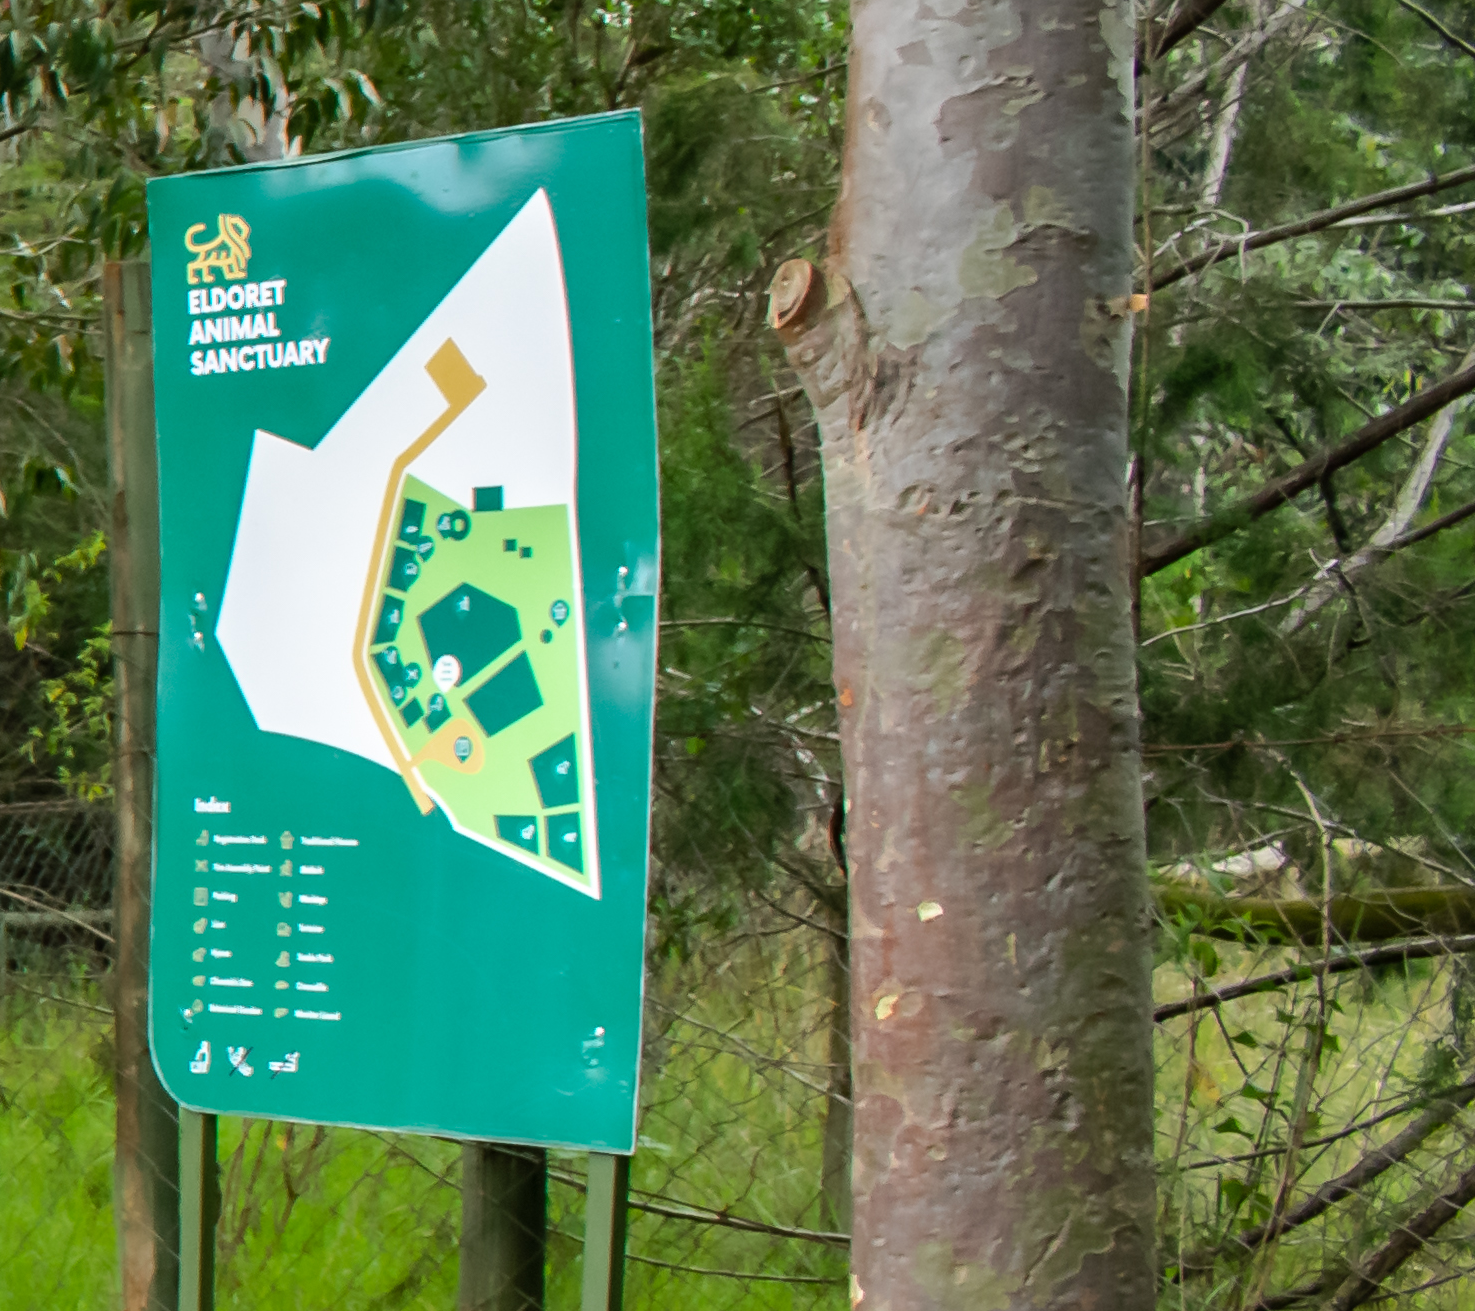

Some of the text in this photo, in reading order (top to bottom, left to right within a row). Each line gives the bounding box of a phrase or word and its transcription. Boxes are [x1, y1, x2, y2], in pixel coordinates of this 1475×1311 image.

[188, 279, 286, 314] ELDORET
[189, 312, 280, 345] ANIMAL
[190, 338, 329, 376] SANCTUARY
